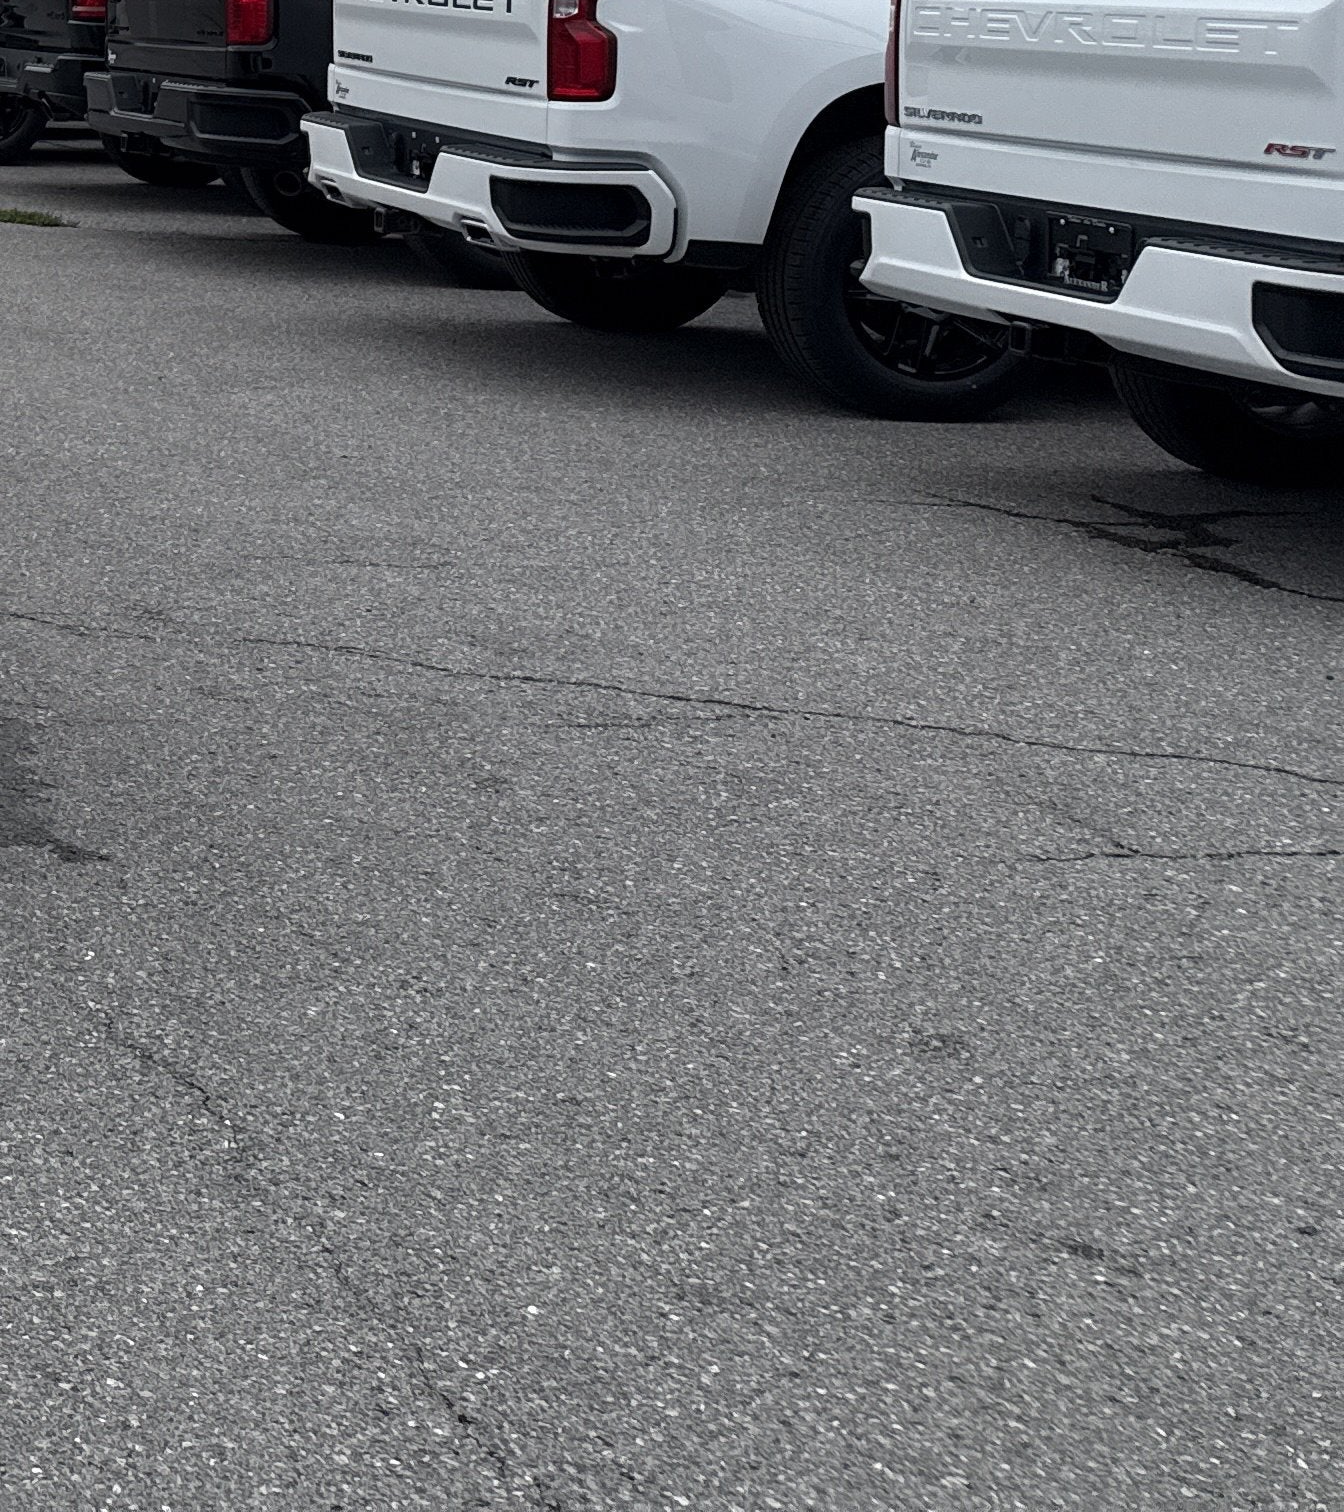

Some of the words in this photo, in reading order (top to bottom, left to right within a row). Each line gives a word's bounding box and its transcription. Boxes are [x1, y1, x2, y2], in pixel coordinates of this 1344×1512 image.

[913, 5, 1301, 56] CHEVROLET
[504, 75, 540, 89] RST
[1262, 141, 1337, 161] RST
